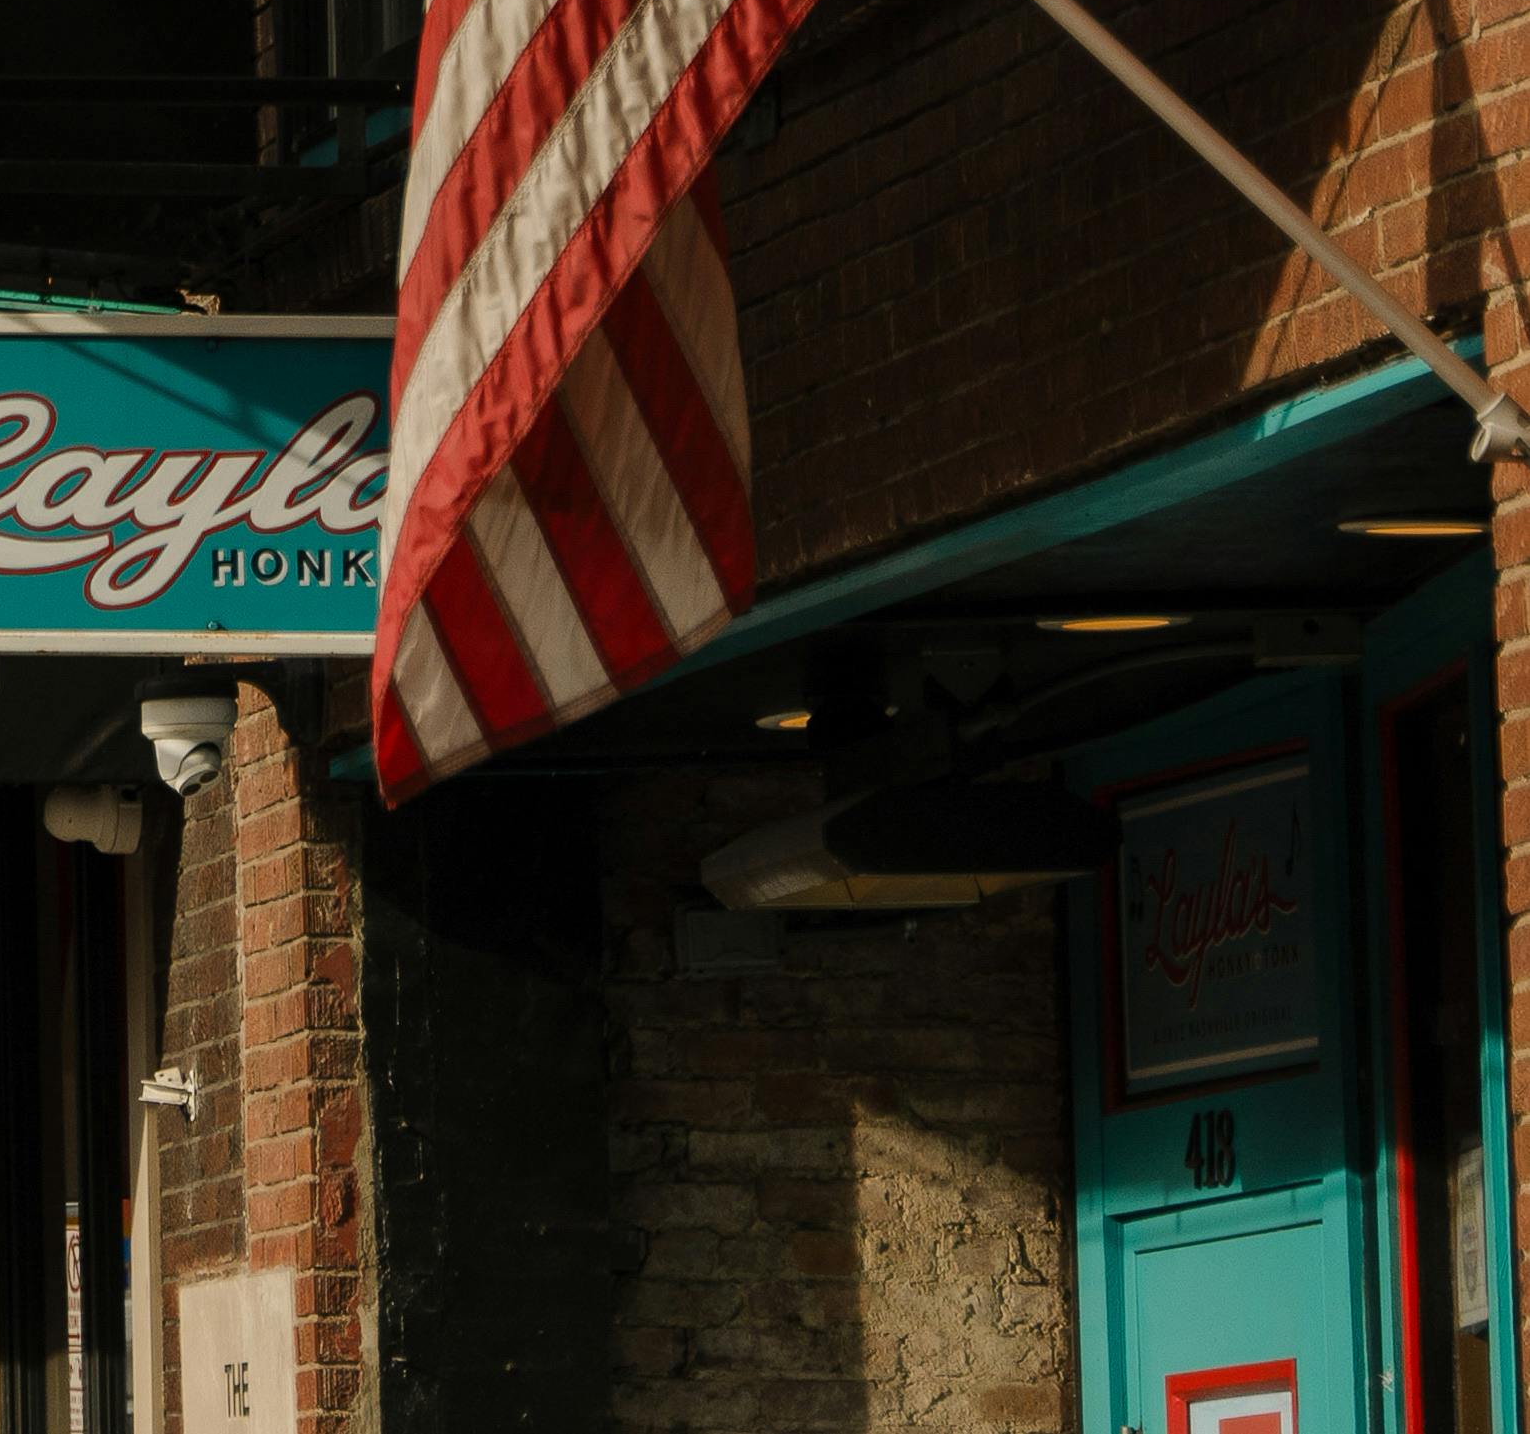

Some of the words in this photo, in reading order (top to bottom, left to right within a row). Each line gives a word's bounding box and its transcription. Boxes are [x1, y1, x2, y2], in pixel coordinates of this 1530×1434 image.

[211, 547, 379, 588] HONK
[1184, 1110, 1237, 1189] 418
[223, 1361, 250, 1418] THE
